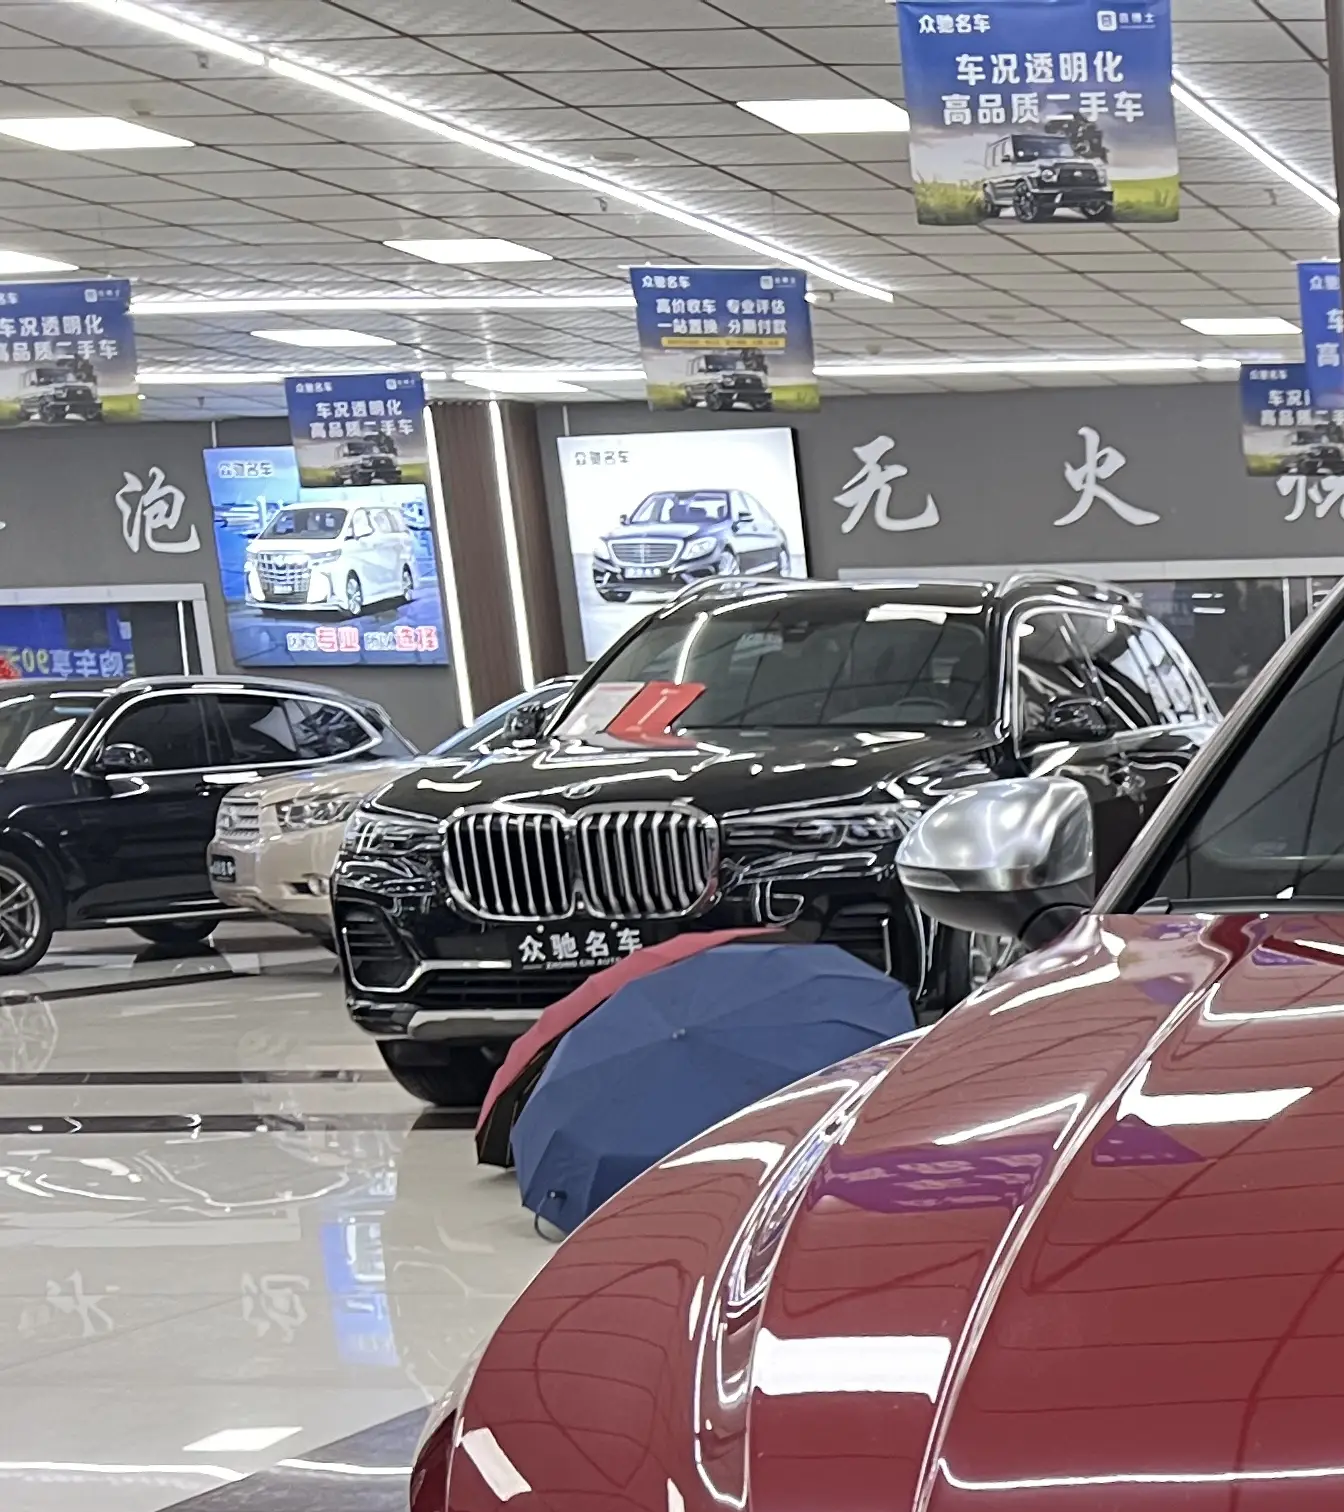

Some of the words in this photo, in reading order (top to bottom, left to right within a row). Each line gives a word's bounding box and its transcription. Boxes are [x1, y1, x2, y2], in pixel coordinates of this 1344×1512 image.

[918, 14, 990, 34] 众驰名车
[955, 50, 1124, 86] 车况透明化
[941, 91, 1144, 126] 高品质二手车
[0, 314, 104, 337] 车况透明化
[315, 399, 402, 418] 车况透明化
[1268, 389, 1311, 407] 车况
[309, 419, 414, 438] 高品质二手车
[115, 466, 200, 553] 泡
[519, 928, 642, 962] 众驰名车
